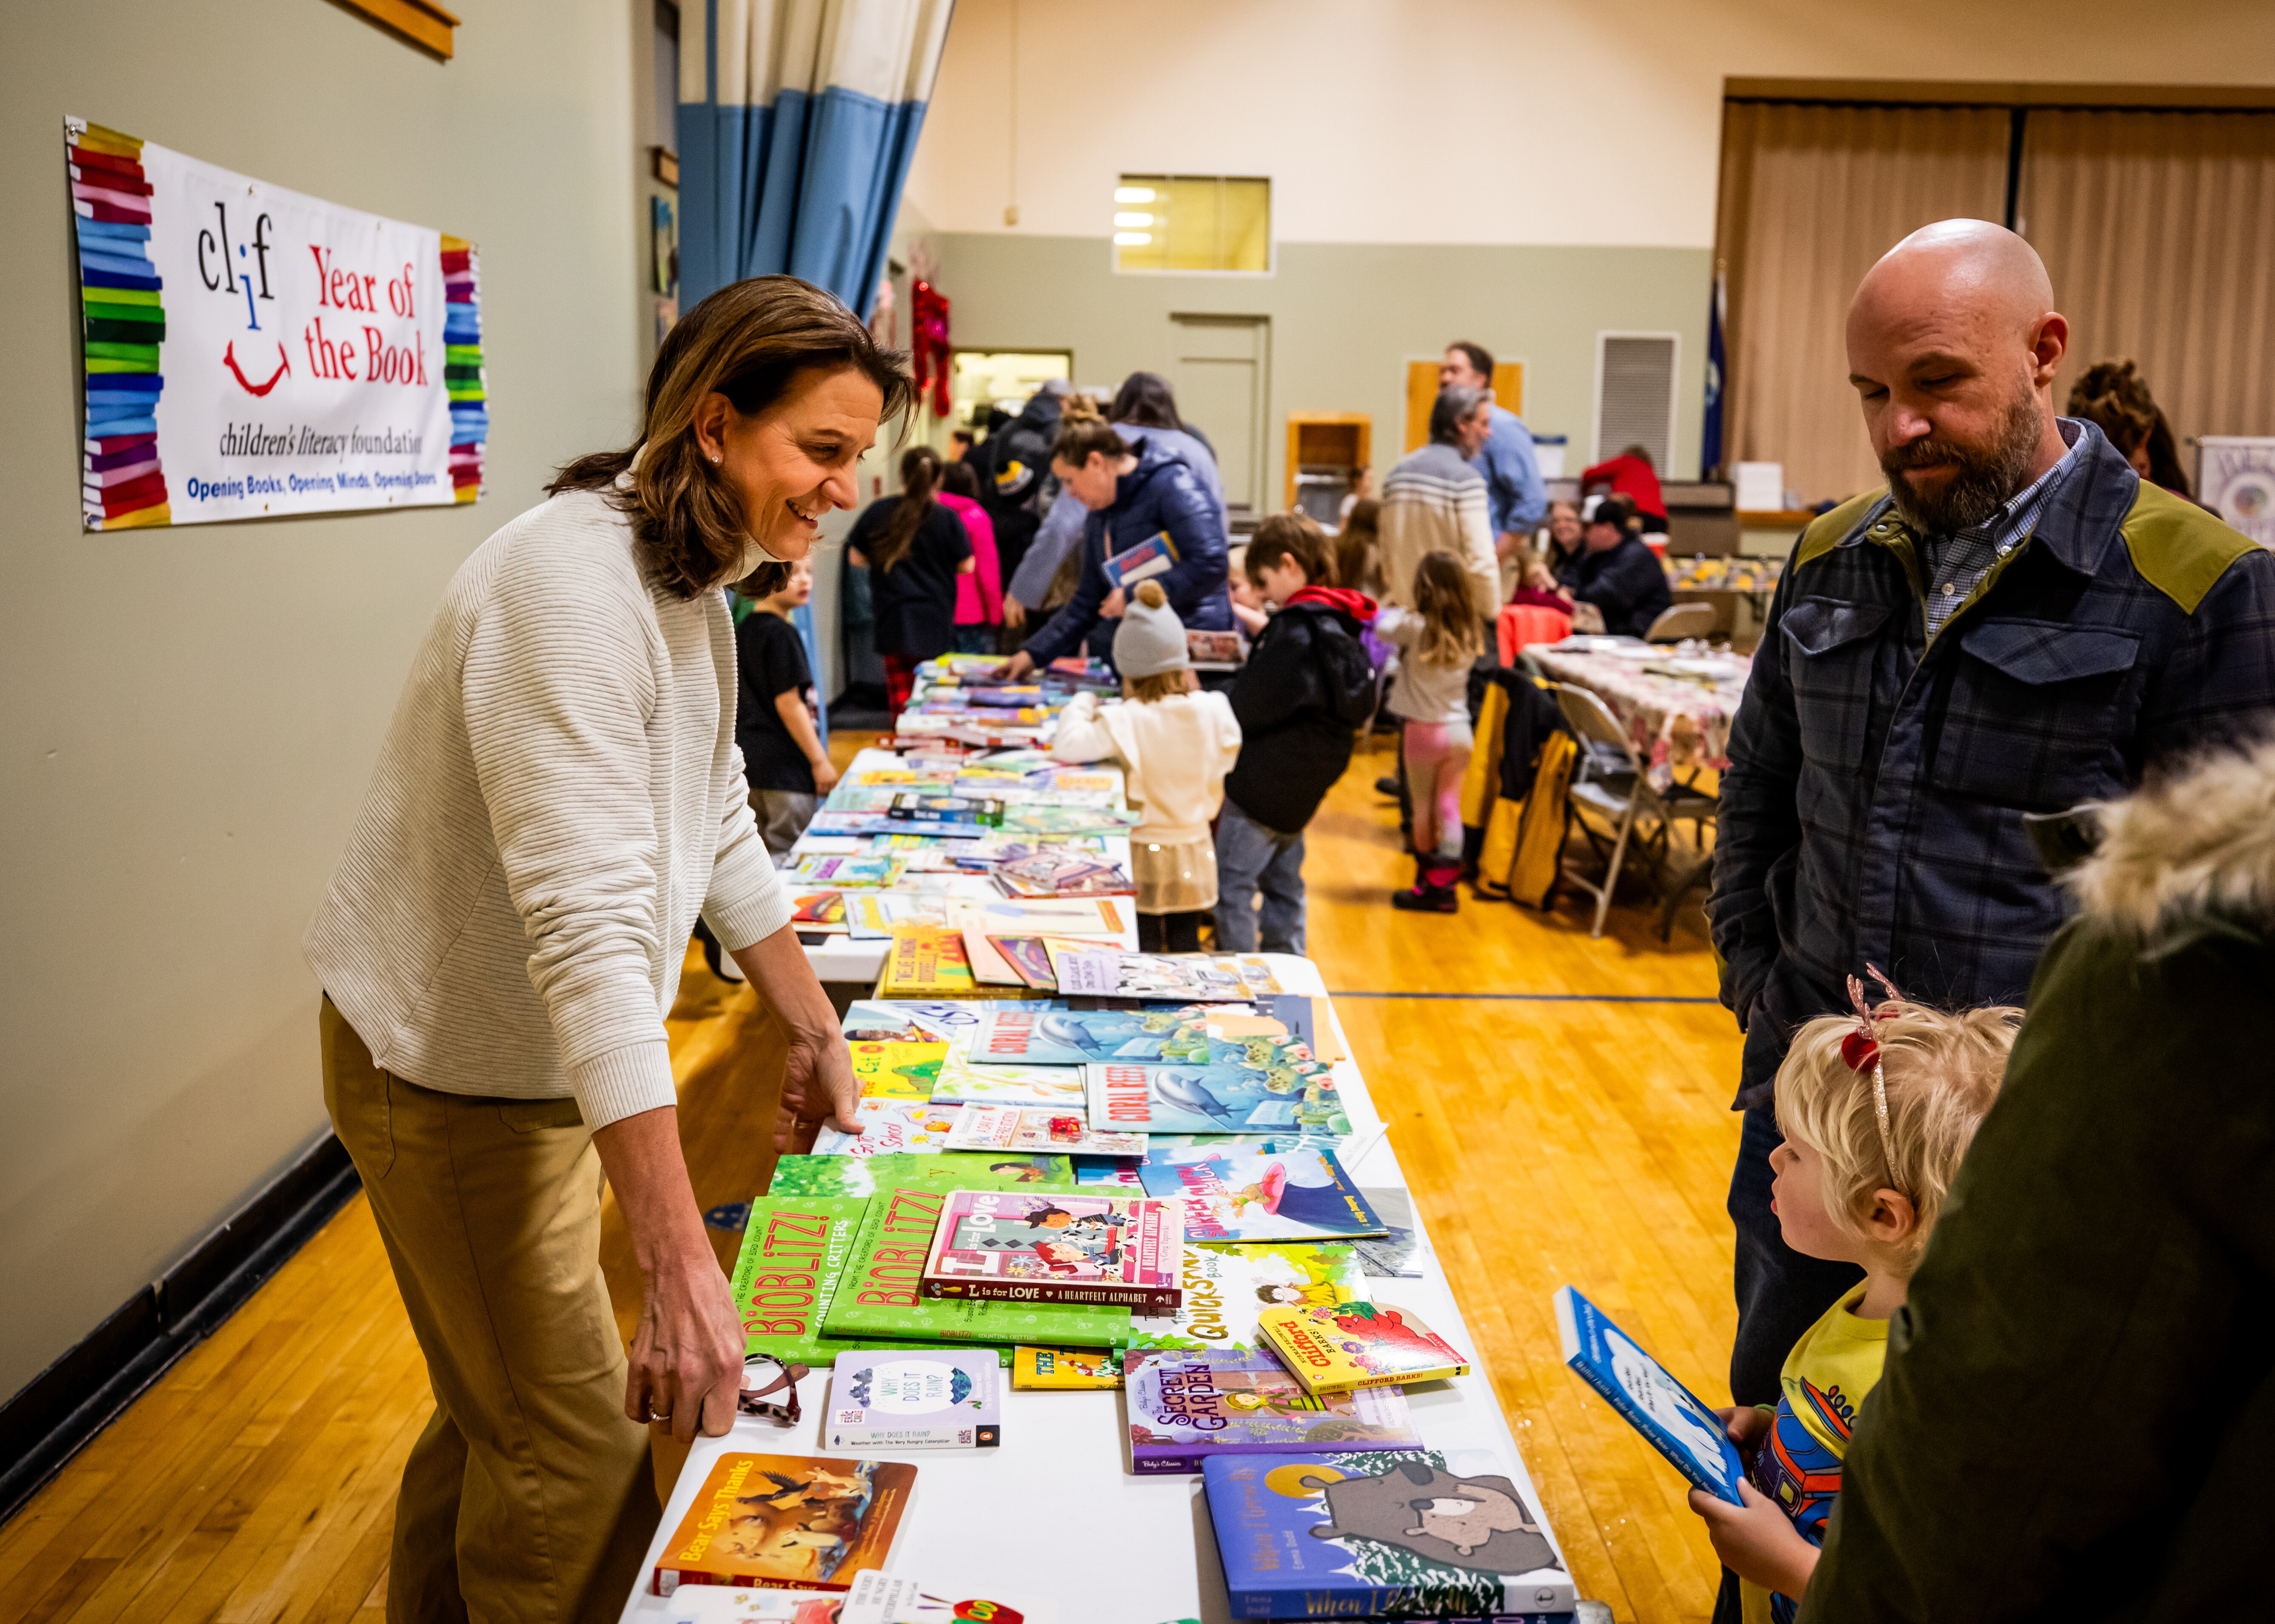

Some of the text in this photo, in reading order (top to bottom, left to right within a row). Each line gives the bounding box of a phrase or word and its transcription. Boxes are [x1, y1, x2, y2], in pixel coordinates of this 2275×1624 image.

[308, 244, 414, 319] Year of
[305, 316, 428, 386] the Book
[220, 423, 296, 456] children's
[298, 425, 349, 464] literacy
[188, 477, 244, 501] Opening
[247, 475, 286, 495] Books,
[289, 473, 335, 493] Opening
[374, 471, 413, 489] Opening
[989, 1029, 1032, 1053] CORAL
[1106, 1066, 1151, 1122] CORAL REEFS
[879, 1122, 903, 1148] School
[1174, 1162, 1228, 1196] CHICK
[875, 1202, 885, 1217] COUNT
[1180, 1199, 1229, 1238] SURFER
[753, 1225, 763, 1242] COUNT
[870, 1218, 880, 1230] BIRD
[1145, 1212, 1159, 1237] ALPHABET
[1160, 1225, 1171, 1244] Paprocki
[968, 1232, 981, 1242] for
[749, 1244, 759, 1255] BIRD
[859, 1239, 873, 1263] CREATORS
[1142, 1237, 1157, 1266] HEARTFELT
[1160, 1246, 1170, 1257] Greg
[815, 1220, 848, 1328] COUNTING CRITTERS
[853, 1264, 864, 1274] THE
[941, 1250, 1000, 1275] L
[1204, 1255, 1223, 1278] BOOK
[739, 1265, 753, 1291] CREATORS
[848, 1275, 859, 1289] FROM
[736, 1293, 745, 1303] THE
[969, 1285, 1147, 1303] L is for LOVE A HEARTFELT ALPHABET
[964, 1308, 974, 1322] Susan
[1272, 1325, 1307, 1364] NORMAN BRIDWELL
[1278, 1321, 1331, 1367] Clifford
[1307, 1329, 1336, 1353] BARKS!
[1036, 1351, 1054, 1375] THE
[881, 1378, 898, 1396] WHY
[925, 1375, 943, 1398] RAIN?
[1357, 1376, 1394, 1386] CLIFFORD
[1396, 1373, 1423, 1382] BARKS!
[903, 1382, 921, 1402] DOES
[1140, 1395, 1151, 1410] Baby's
[1157, 1368, 1192, 1426] SECRET
[1184, 1364, 1228, 1431] GARDEN
[845, 1410, 853, 1423] ERIC
[853, 1410, 863, 1423] CARLE
[1152, 1405, 1163, 1416] The
[1142, 1461, 1160, 1469] Baby's
[1641, 1424, 1656, 1438] Polar
[1670, 1450, 1683, 1466] What
[1682, 1464, 1691, 1473] Do
[1692, 1471, 1702, 1483] You
[679, 1460, 754, 1562] Bear Says Thanks
[1306, 1589, 1361, 1616] When
